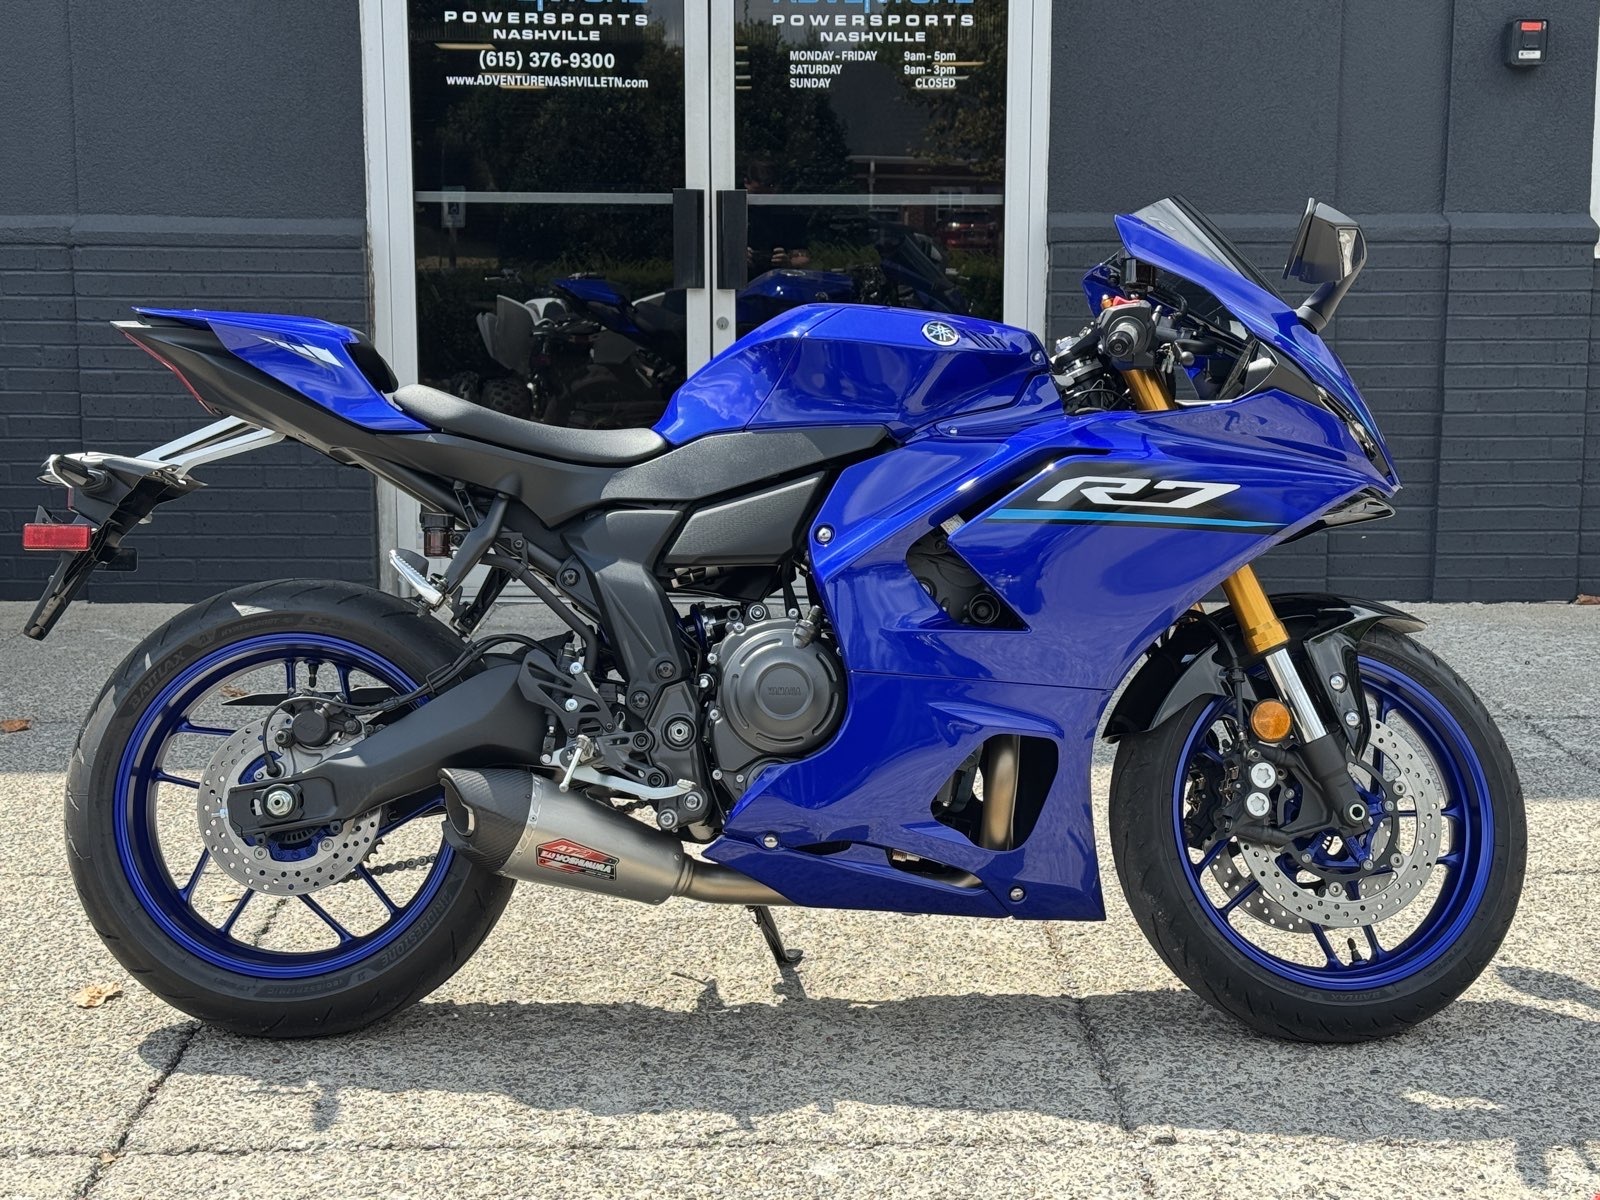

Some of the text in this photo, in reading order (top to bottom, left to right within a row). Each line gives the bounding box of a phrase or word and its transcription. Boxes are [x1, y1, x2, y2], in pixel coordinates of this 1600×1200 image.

[444, 11, 649, 27] POWERSPORTS
[772, 14, 975, 27] POWERSPORTS
[493, 29, 601, 42] NASHVILLE
[820, 31, 926, 43] NASHVILLE
[479, 50, 615, 71] (615) 376-9300
[789, 64, 843, 75] SATURDAY
[446, 74, 649, 89] www.ADVENTURENASHVILLETN.com
[789, 78, 832, 89] SUNDAY
[915, 78, 956, 89] CLOSED
[1036, 475, 1242, 510] R7
[767, 686, 802, 696] YAMAHA
[555, 853, 612, 873] YOSHIMURA
